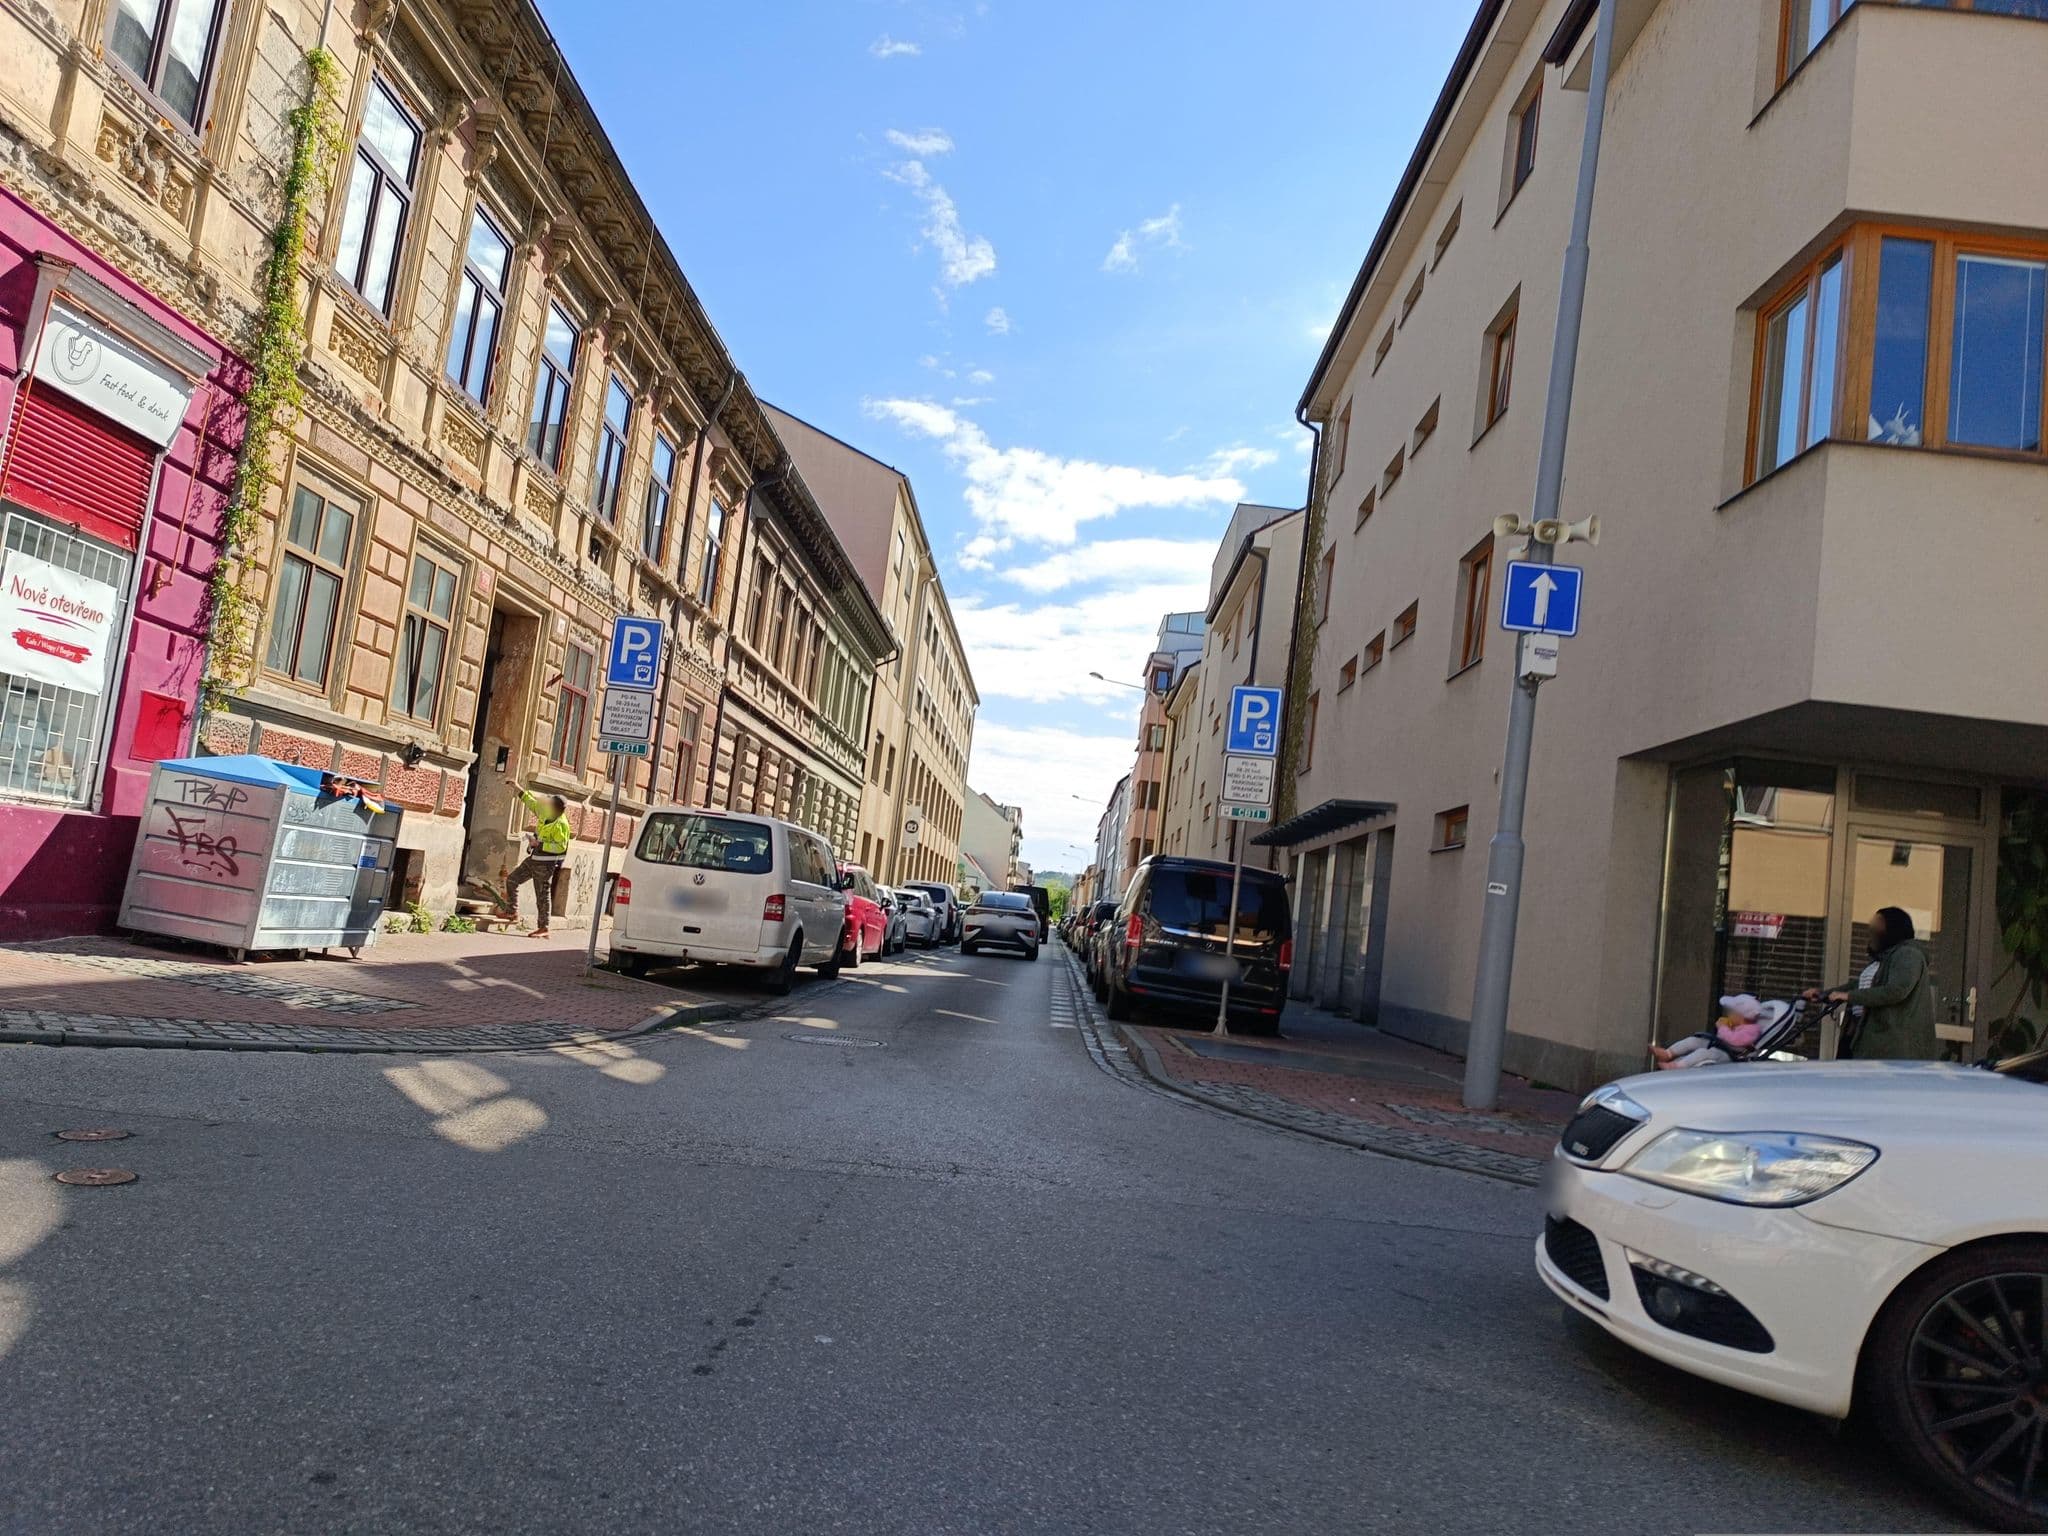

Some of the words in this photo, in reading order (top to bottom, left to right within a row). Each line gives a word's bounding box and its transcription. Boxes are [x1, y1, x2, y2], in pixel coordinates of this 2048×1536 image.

[99, 373, 119, 390] Fast
[116, 383, 137, 402] food
[137, 396, 147, 410] &
[148, 401, 169, 421] drink
[10, 574, 48, 606] Nově
[50, 594, 104, 624] otevřeno
[620, 625, 651, 664] P
[1239, 695, 1270, 733] P
